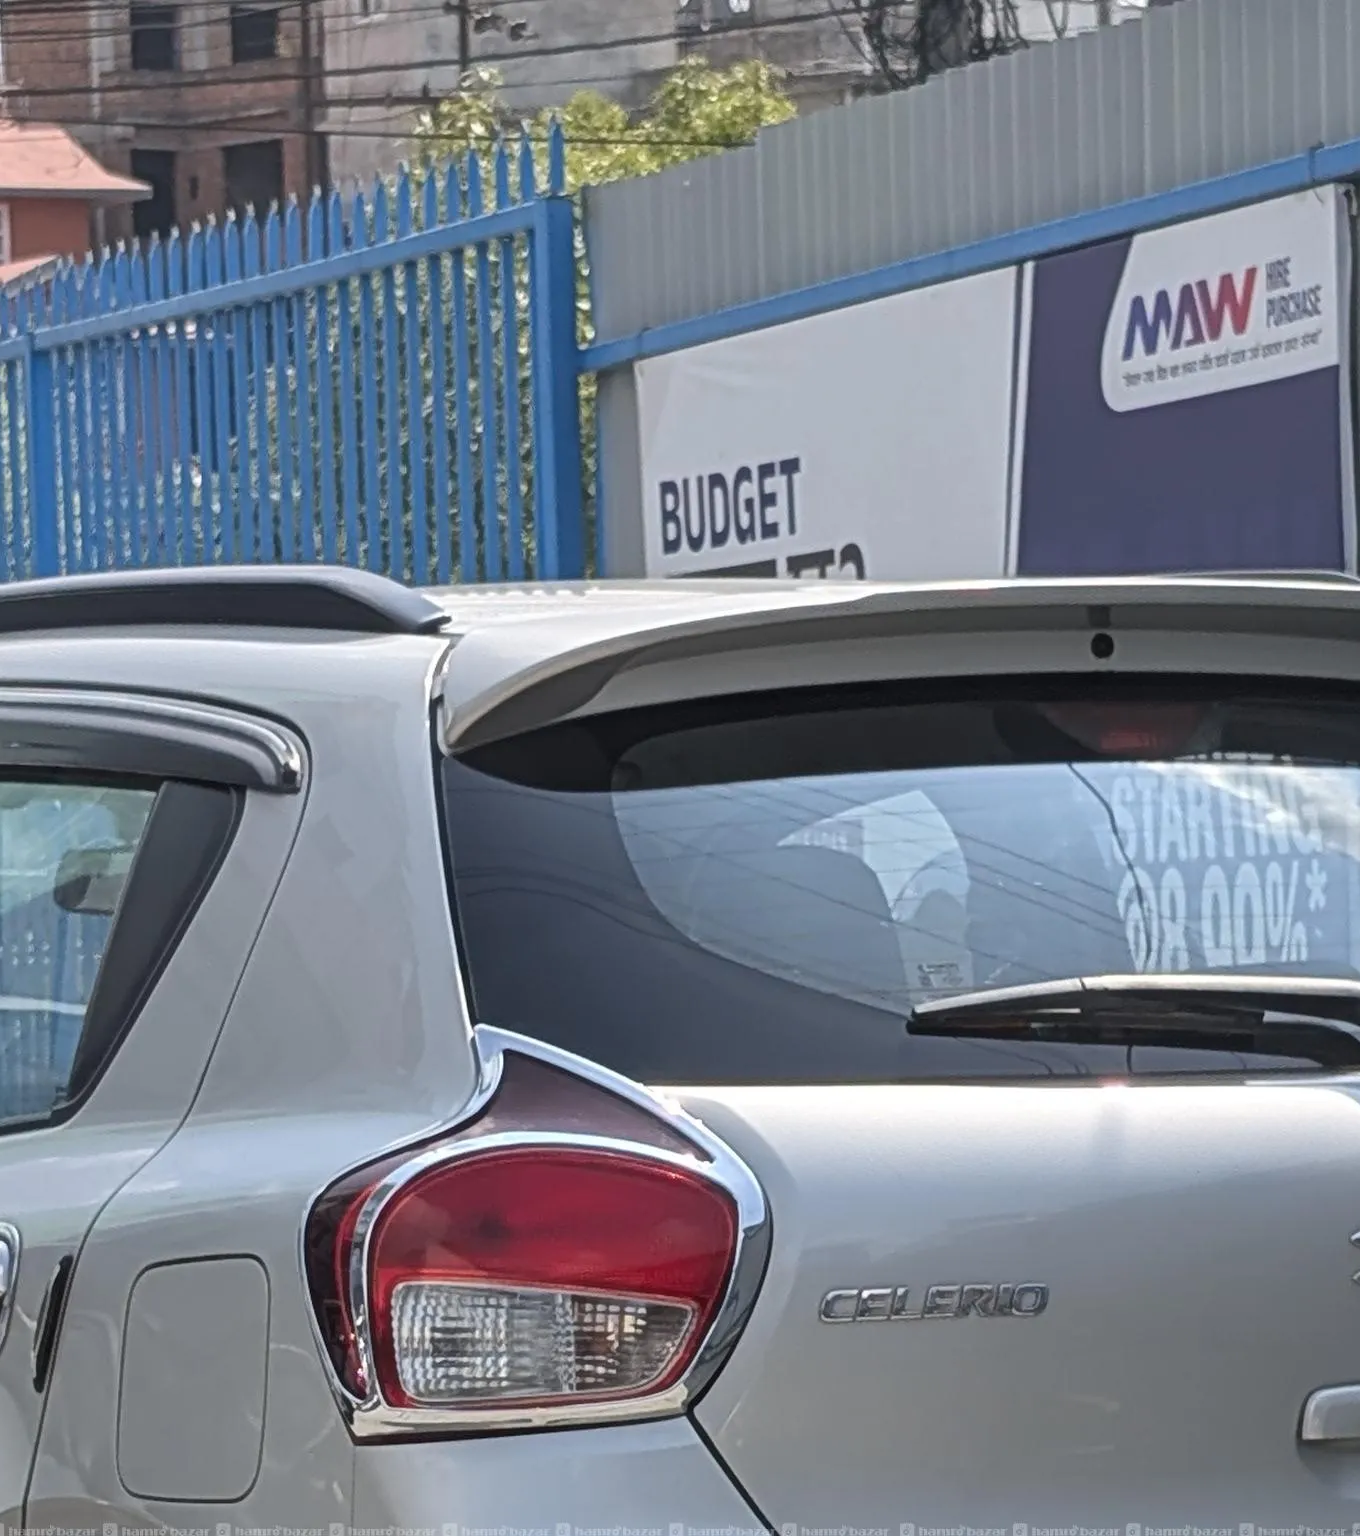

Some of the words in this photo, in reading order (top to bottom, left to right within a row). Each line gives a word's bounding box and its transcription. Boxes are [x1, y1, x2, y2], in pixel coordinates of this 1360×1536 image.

[1122, 266, 1257, 361] MAW
[659, 457, 801, 556] BUDGET
[817, 1282, 1049, 1323] CELERIO
